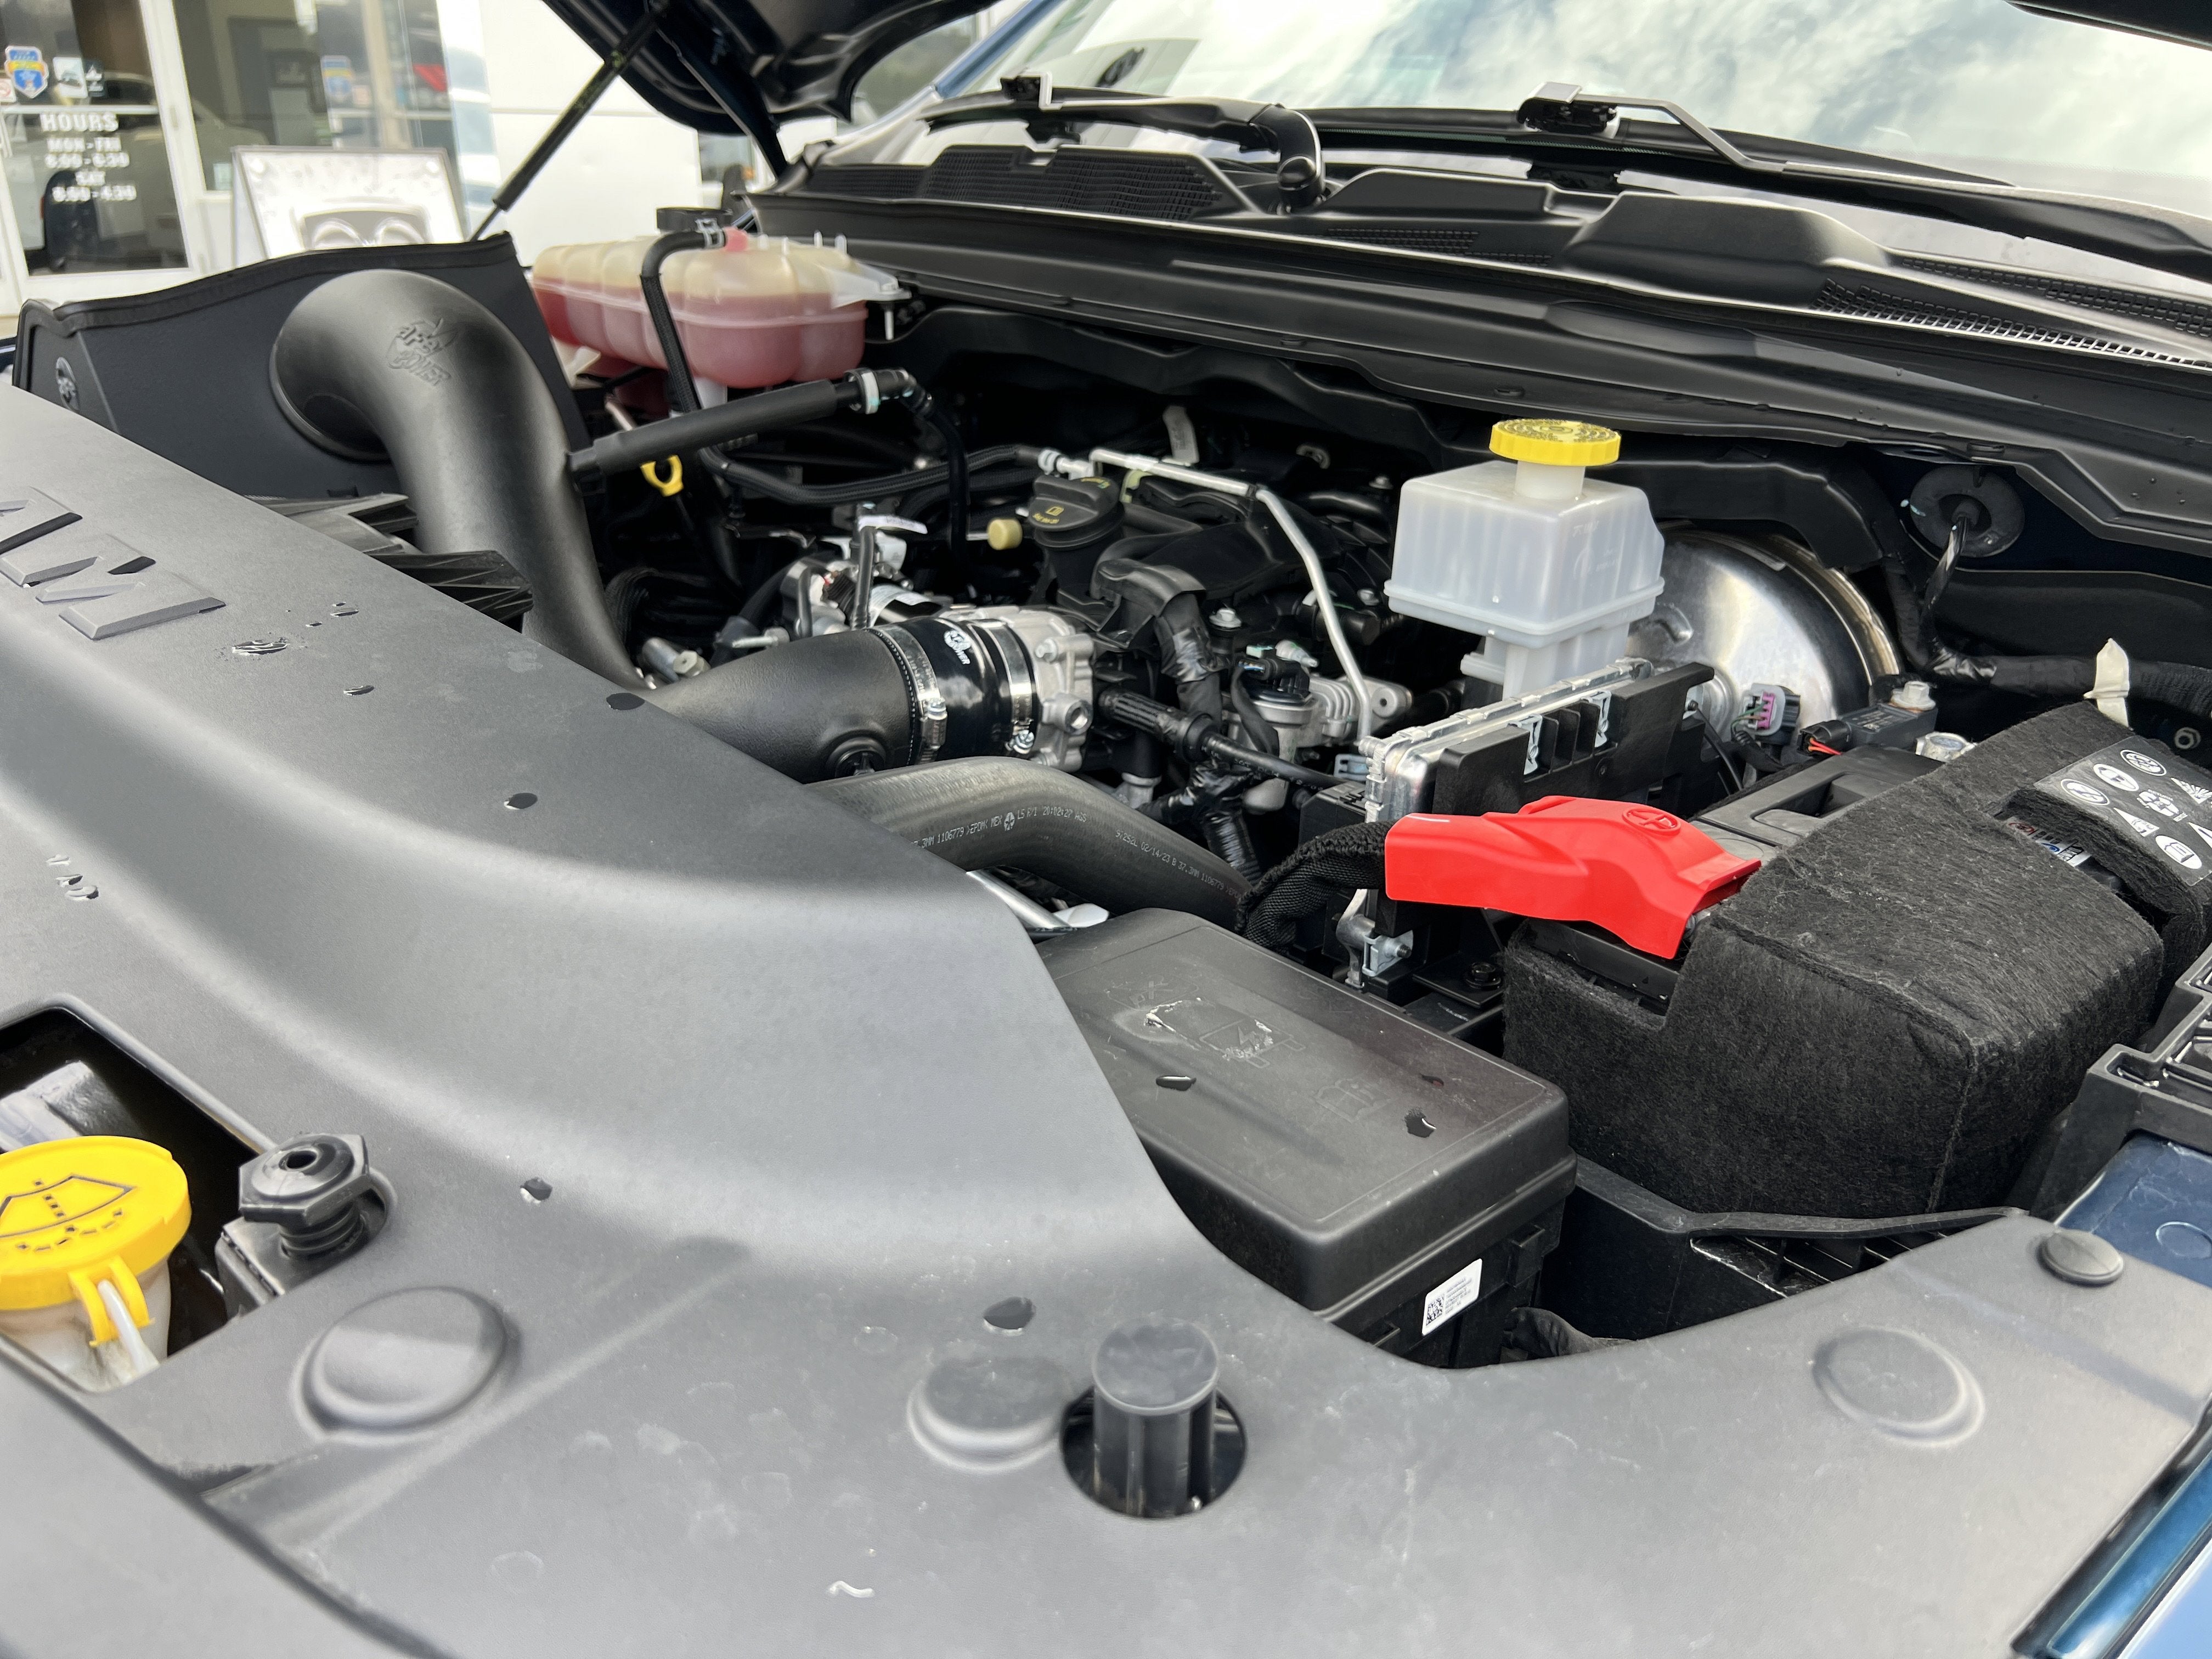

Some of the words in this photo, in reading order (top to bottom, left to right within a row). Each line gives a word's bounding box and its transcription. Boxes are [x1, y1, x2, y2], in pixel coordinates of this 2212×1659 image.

[40, 113, 119, 132] HOURS
[937, 827, 964, 844] 1106779
[991, 815, 1003, 827] MEX
[1042, 806, 1073, 818] 20:02:27
[1141, 842, 1170, 863] 02/14/23
